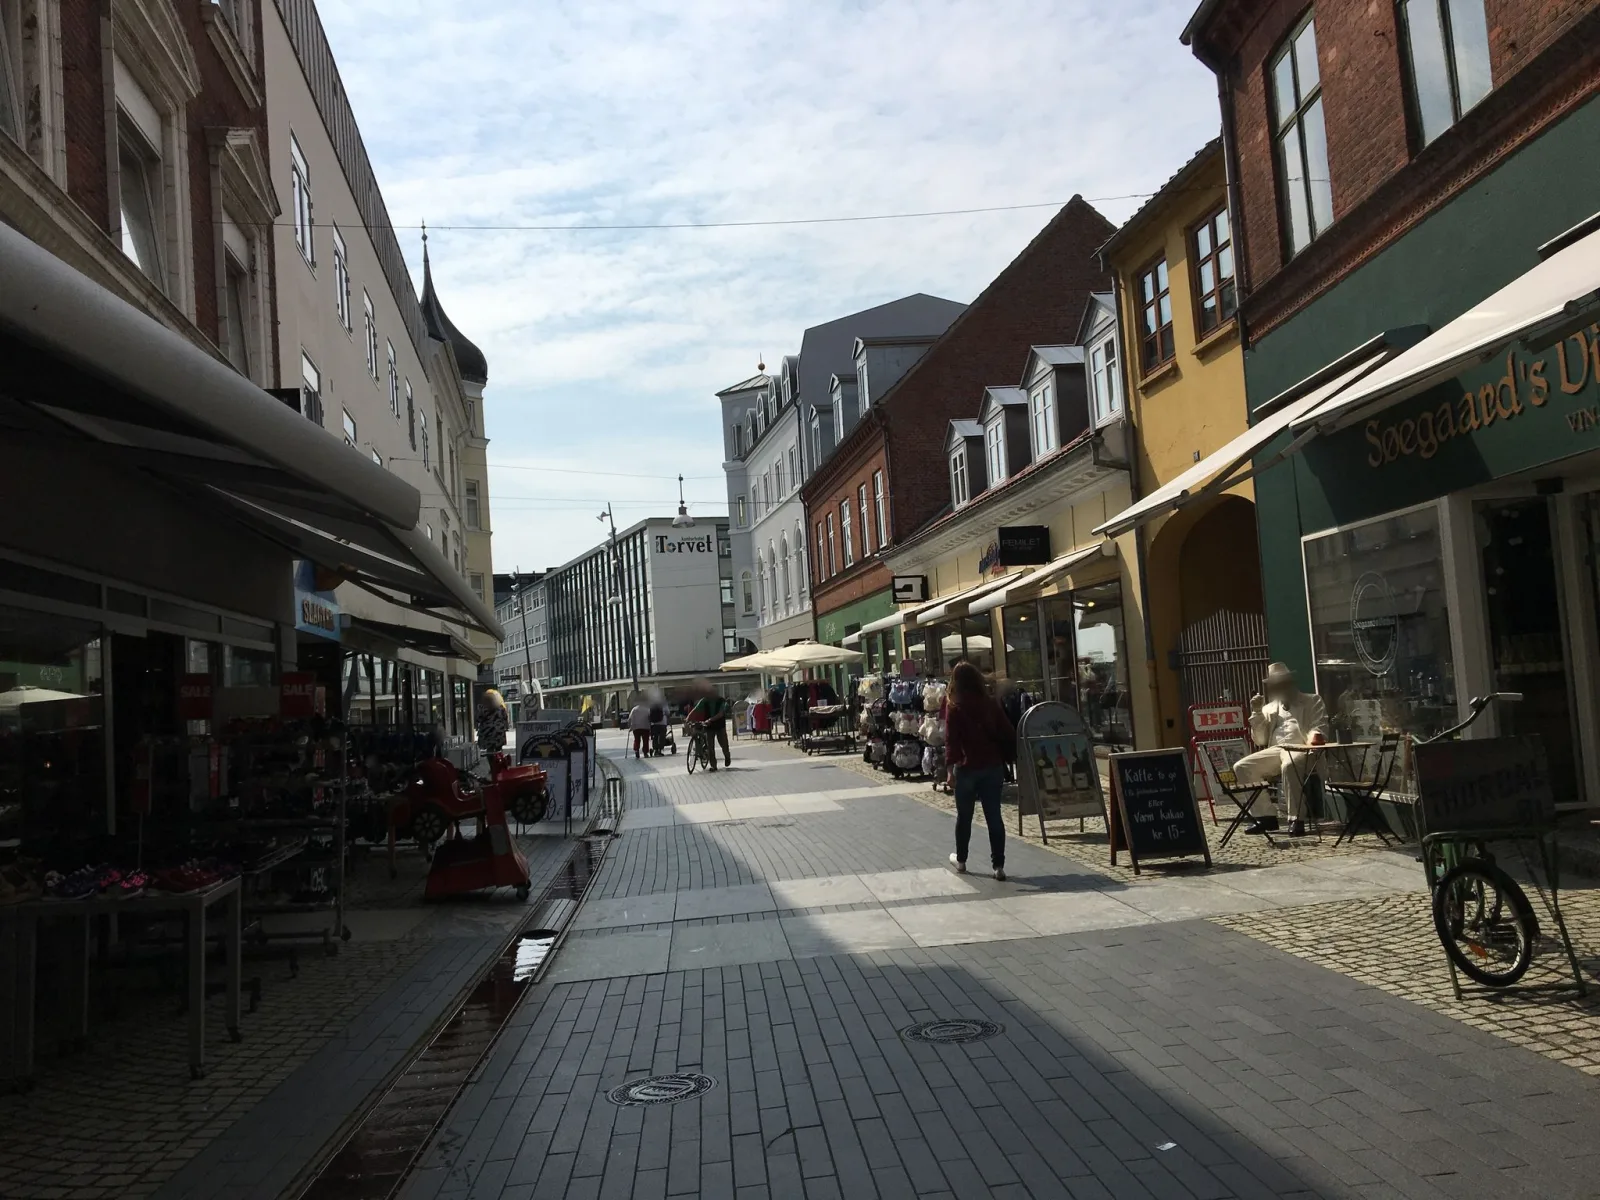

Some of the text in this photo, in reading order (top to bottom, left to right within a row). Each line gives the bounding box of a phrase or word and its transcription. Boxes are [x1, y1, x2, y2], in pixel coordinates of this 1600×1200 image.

[655, 534, 713, 553] Torvet
[180, 684, 212, 698] SALE
[282, 683, 314, 696] SALE
